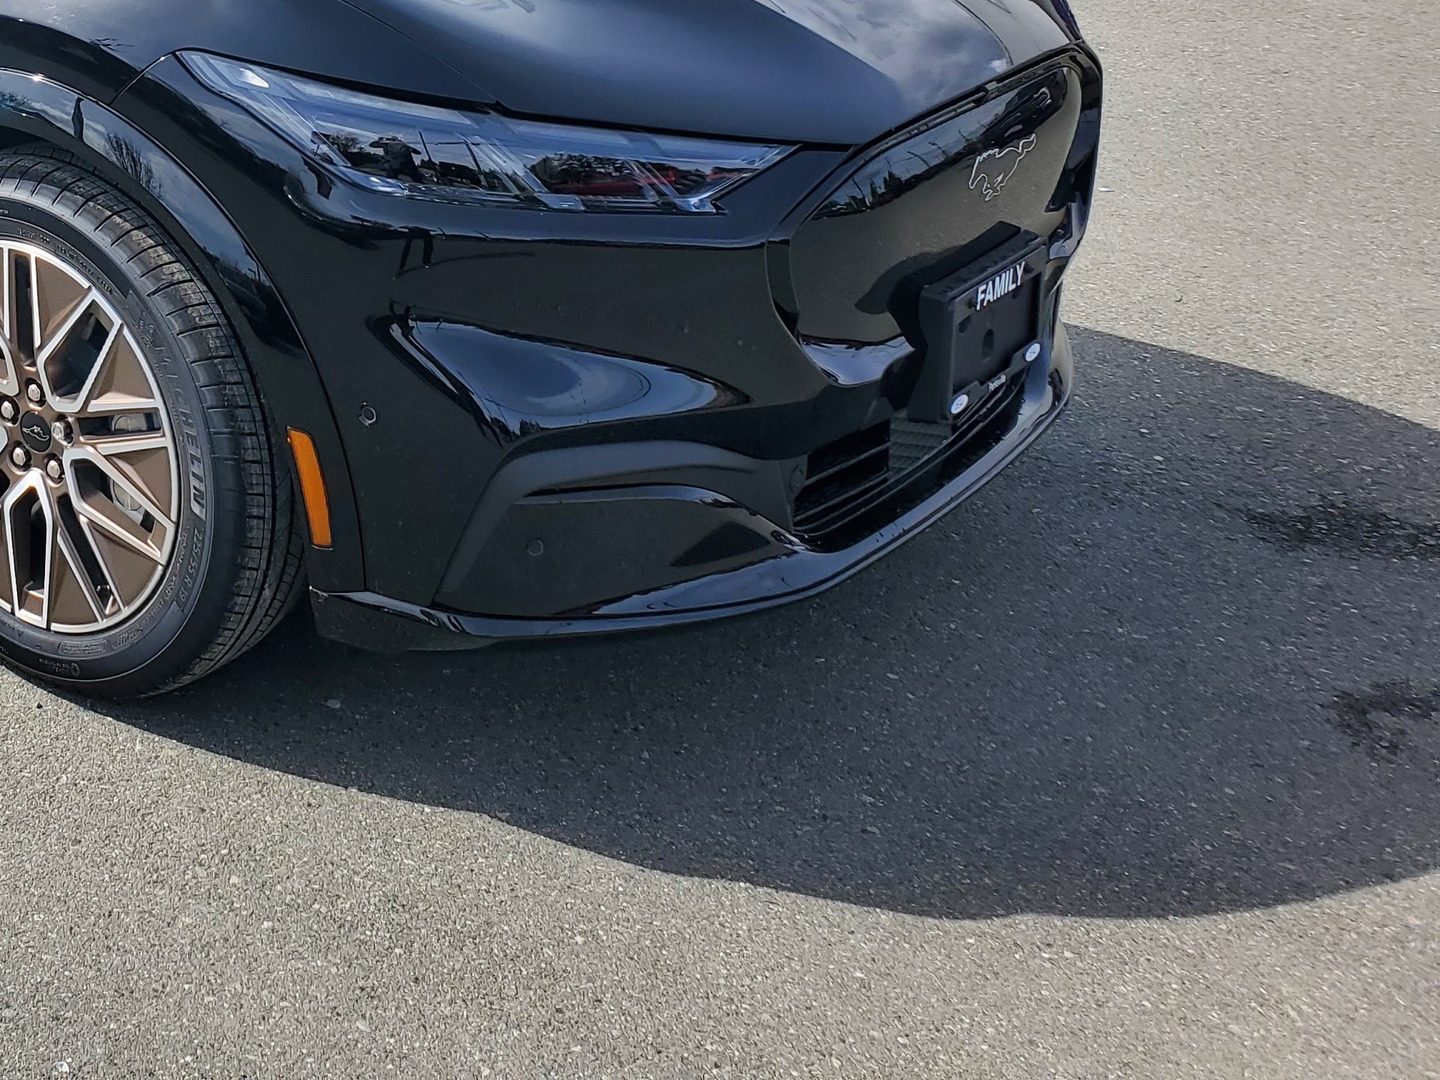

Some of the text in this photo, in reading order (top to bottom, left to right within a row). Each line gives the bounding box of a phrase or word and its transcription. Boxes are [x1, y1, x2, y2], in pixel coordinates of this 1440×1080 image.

[975, 261, 1026, 311] FAMILY
[155, 346, 205, 515] MICHELIN
[188, 527, 203, 577] 225/55
[183, 575, 193, 587] R
